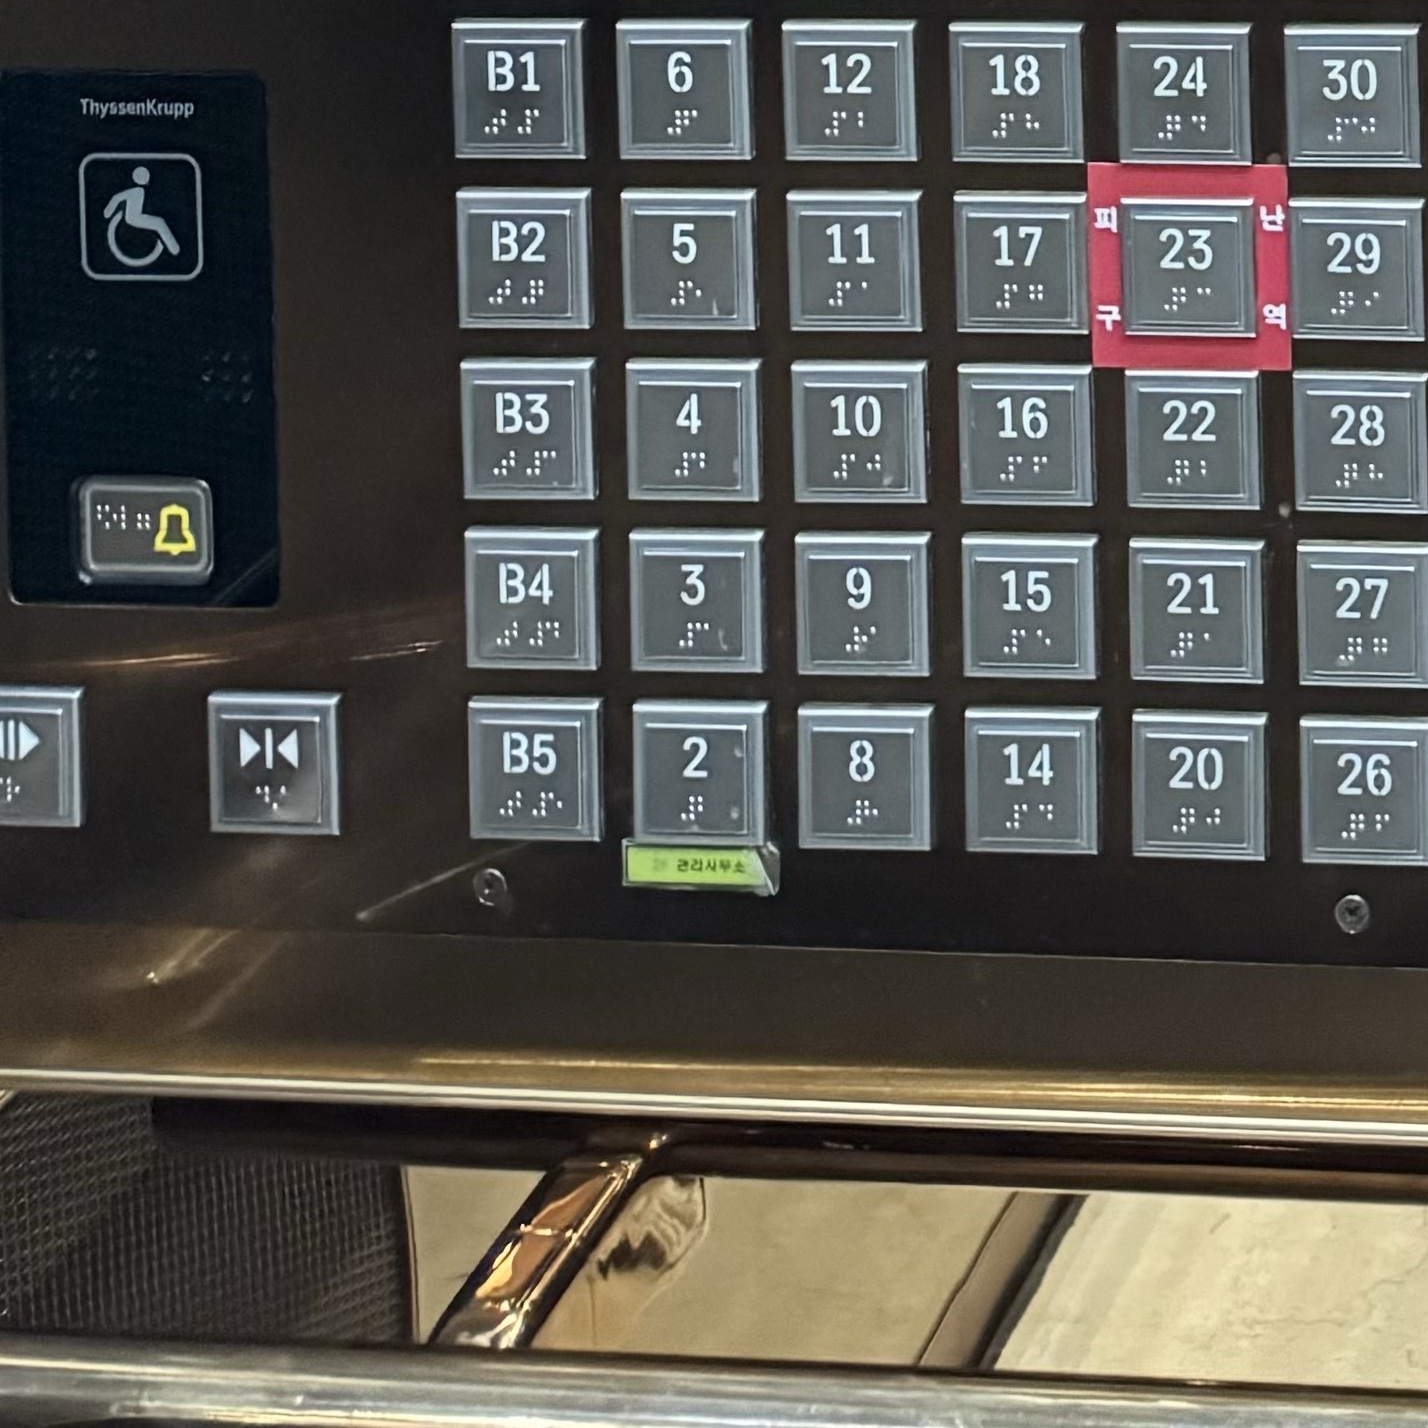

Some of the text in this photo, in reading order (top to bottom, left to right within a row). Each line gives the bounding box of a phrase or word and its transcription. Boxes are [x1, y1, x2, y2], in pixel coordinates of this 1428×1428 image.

[488, 51, 540, 91] B1
[668, 52, 693, 92] 6
[822, 53, 871, 93] 12
[989, 55, 1040, 95] 18
[1154, 56, 1207, 97] 24
[1323, 59, 1377, 100] 30
[80, 98, 195, 120] ThyssenKrupp
[492, 221, 545, 262] B2
[672, 223, 696, 263] 5
[826, 224, 875, 263] 11
[993, 226, 1042, 266] 17
[1159, 228, 1212, 270] 23
[1327, 232, 1380, 274] 29
[1095, 304, 1122, 331] 구
[496, 392, 549, 434] B3
[676, 394, 701, 434] 4
[831, 395, 881, 436] 10
[997, 397, 1047, 438] 16
[1163, 400, 1216, 441] 22
[1331, 405, 1384, 446] 28
[499, 563, 553, 604] B4
[681, 565, 705, 605] 3
[846, 568, 871, 609] 9
[1001, 570, 1051, 612] 15
[1167, 573, 1219, 614] 21
[1336, 578, 1388, 619] 27
[503, 732, 556, 775] B5
[683, 737, 707, 777] 2
[849, 740, 874, 782] 8
[1003, 744, 1053, 785] 14
[1169, 747, 1223, 790] 20
[1338, 753, 1392, 795] 26
